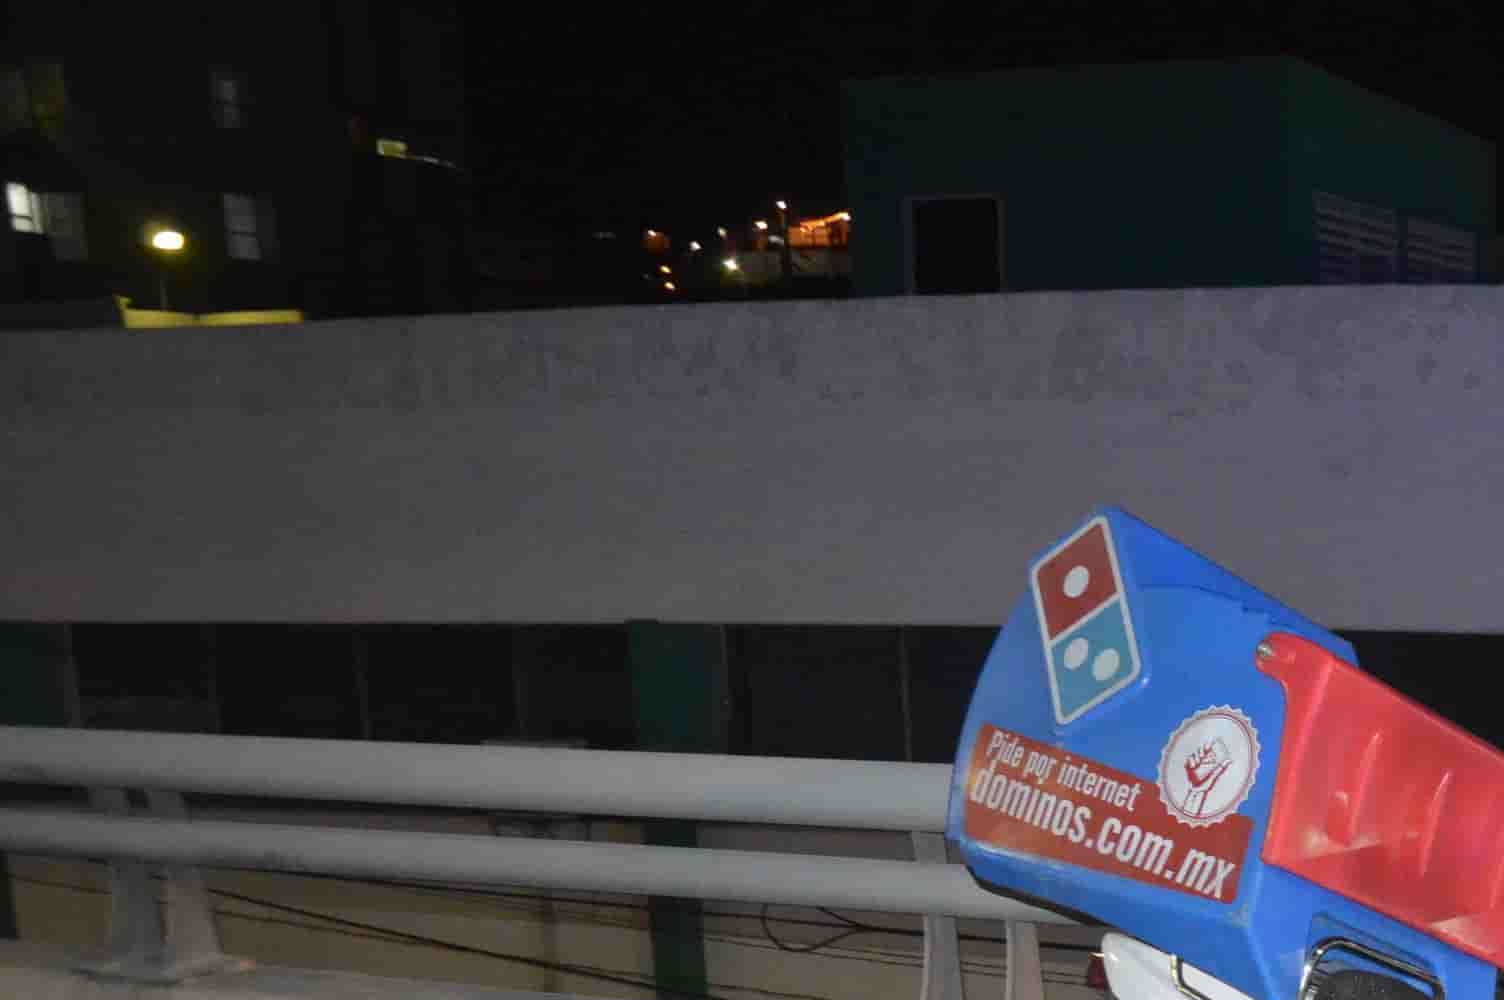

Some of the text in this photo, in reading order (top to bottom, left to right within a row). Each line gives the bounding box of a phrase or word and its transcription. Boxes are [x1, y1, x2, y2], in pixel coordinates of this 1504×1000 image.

[986, 730, 1142, 812] Pide por internet
[970, 761, 1235, 899] dominos.com.mx
